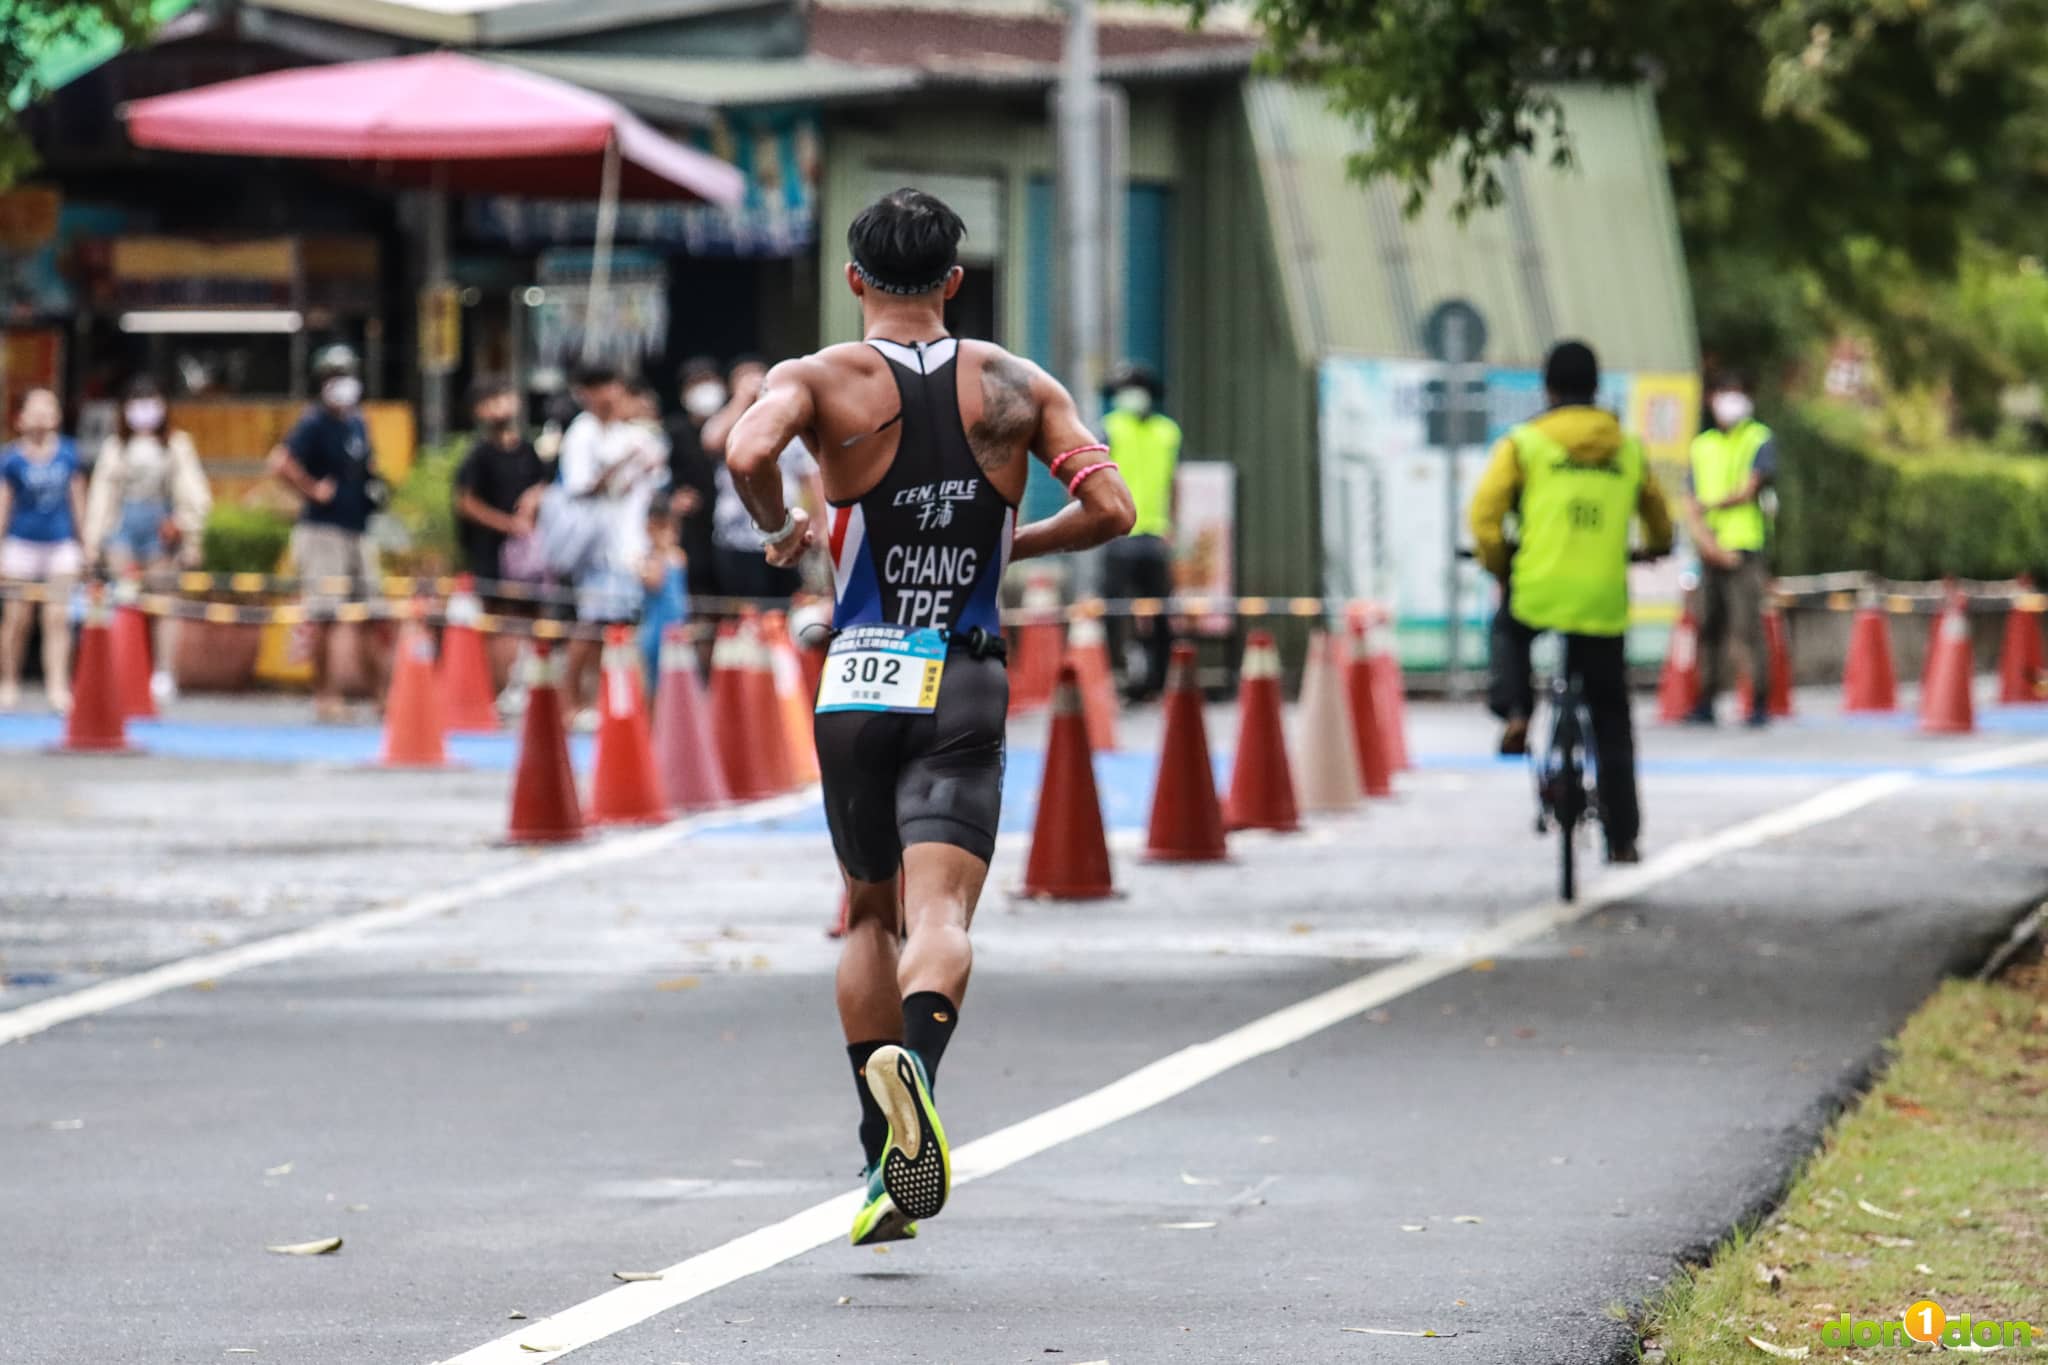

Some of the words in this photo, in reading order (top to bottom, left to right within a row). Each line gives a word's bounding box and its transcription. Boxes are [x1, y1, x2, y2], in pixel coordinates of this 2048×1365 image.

[892, 479, 978, 506] CENIPLE
[885, 544, 977, 586] CHANG
[896, 589, 954, 629] TPE
[842, 657, 901, 686] 302
